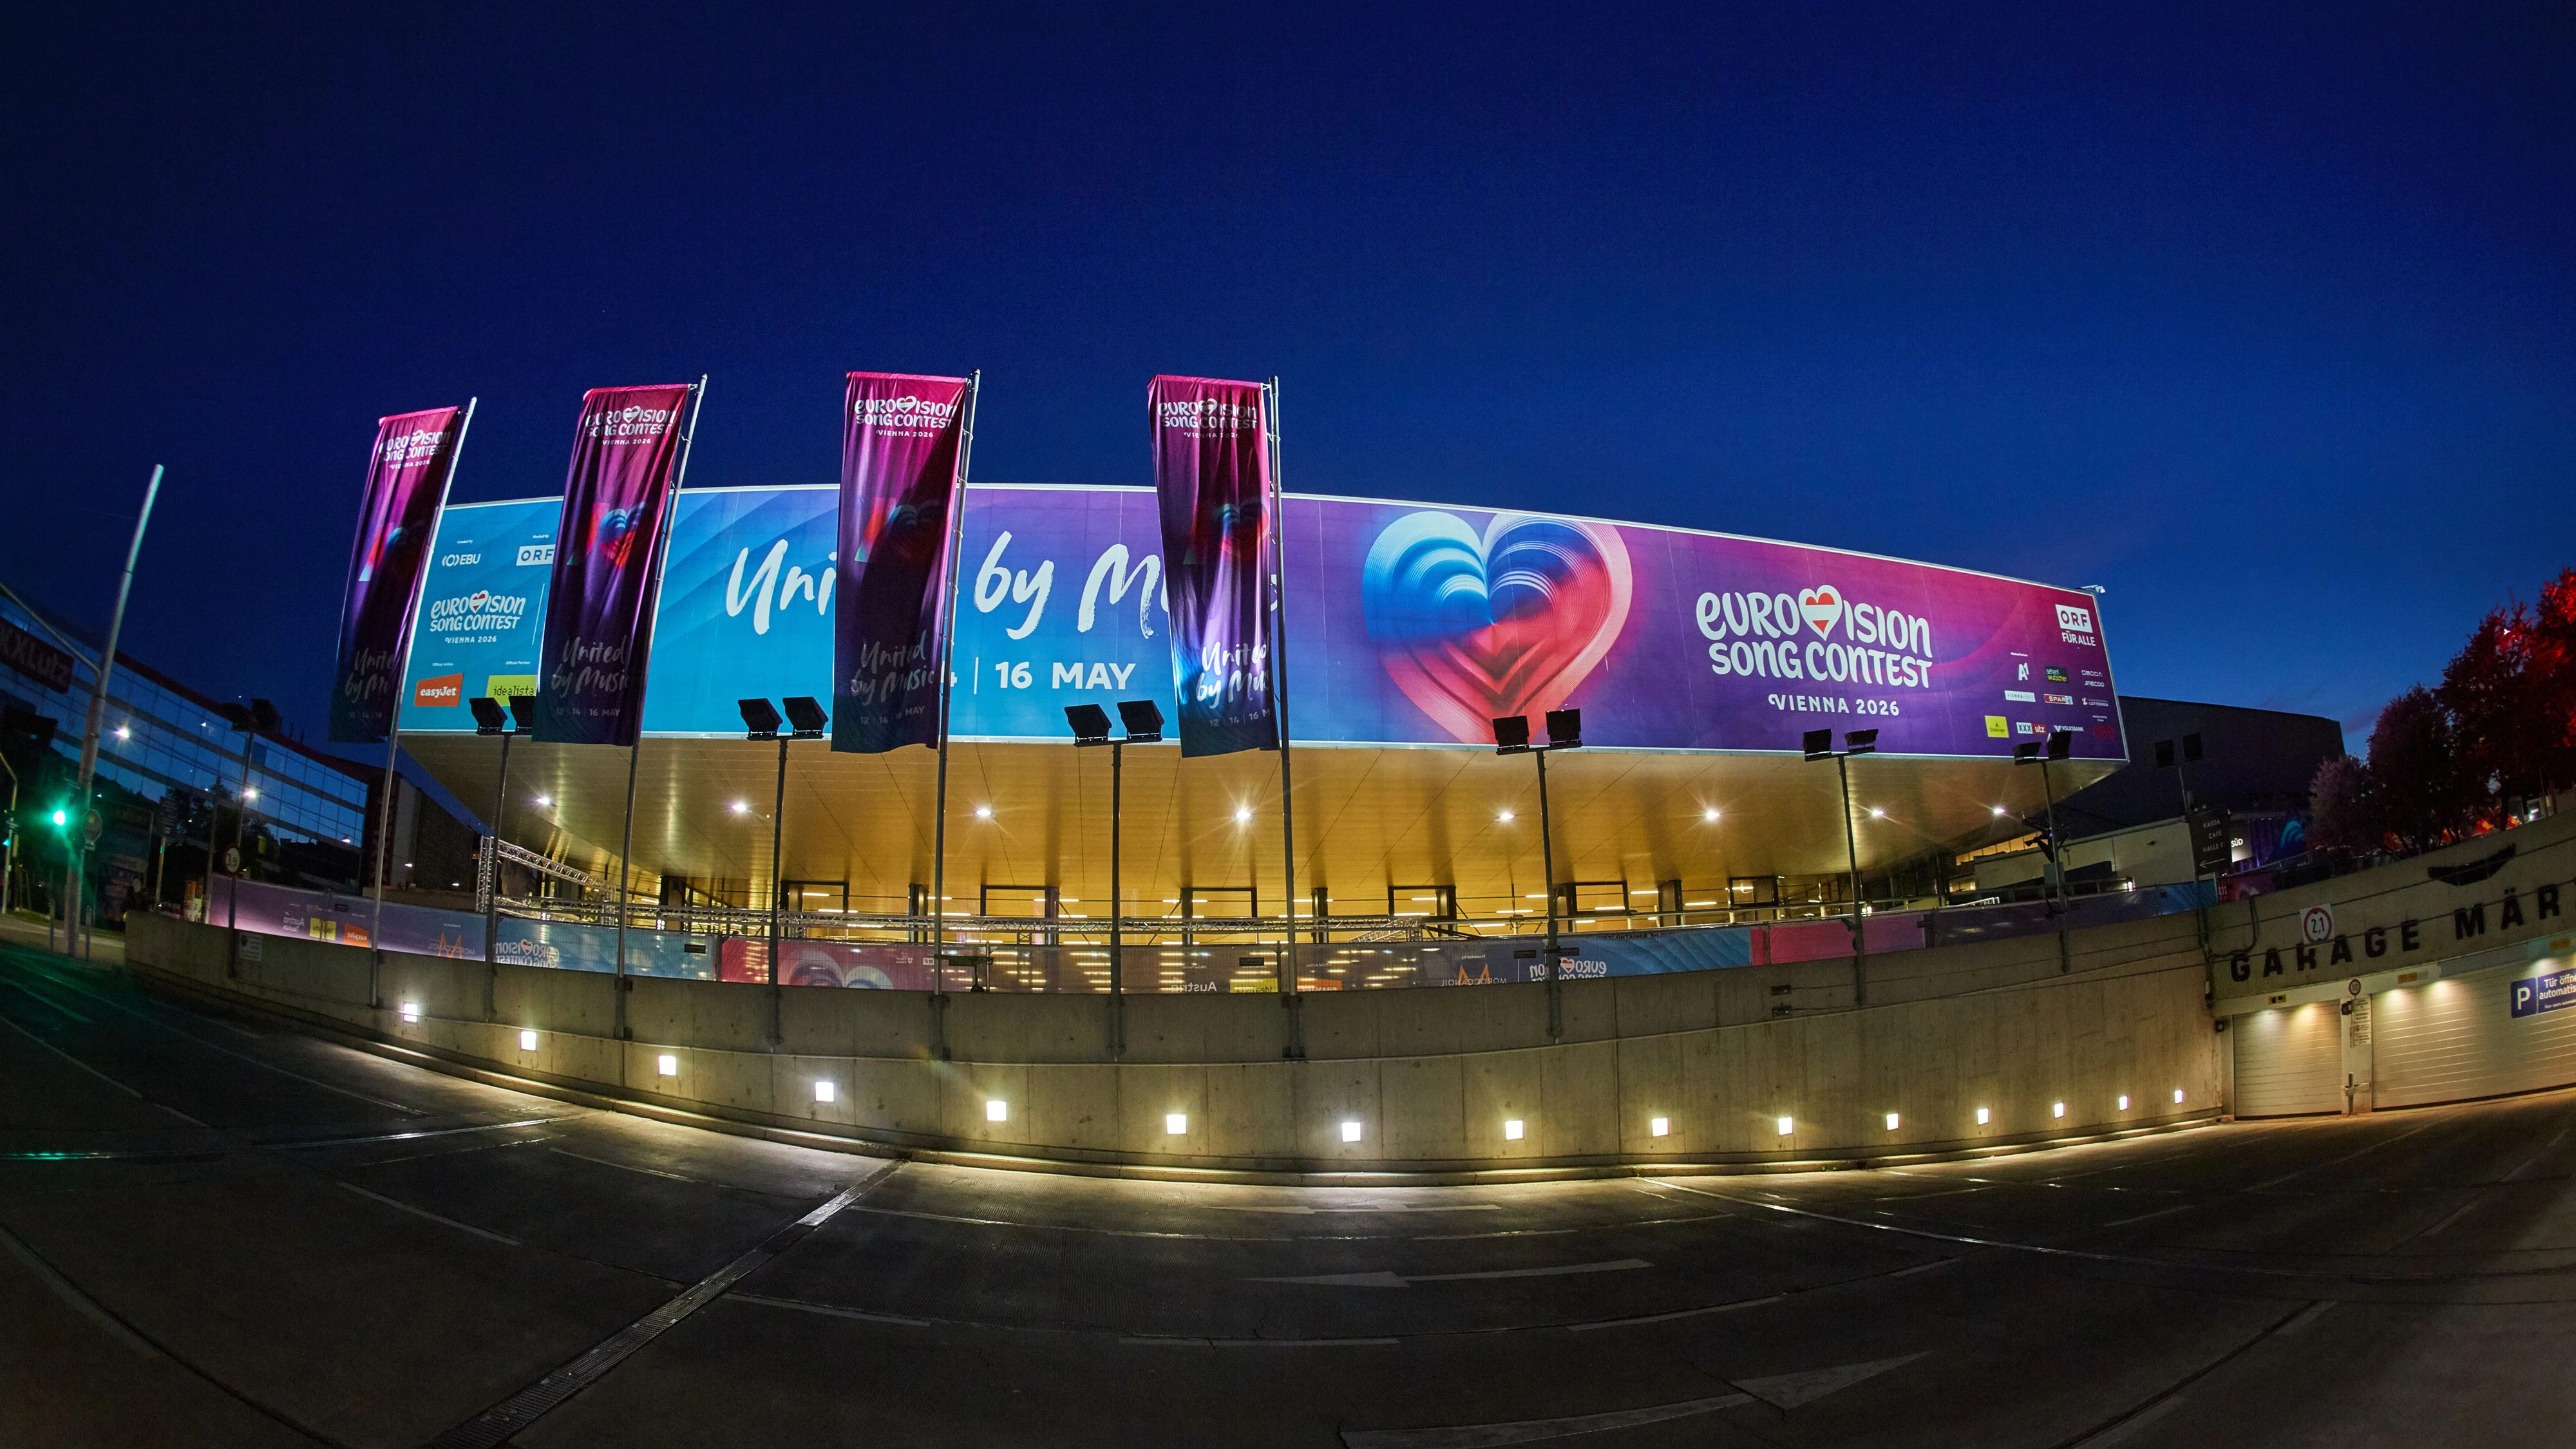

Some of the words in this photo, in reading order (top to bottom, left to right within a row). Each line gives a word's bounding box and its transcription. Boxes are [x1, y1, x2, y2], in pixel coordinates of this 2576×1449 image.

[855, 395, 958, 417] EUROVISION
[1158, 398, 1258, 419] EUROVISION
[618, 423, 672, 436] CONTEST
[857, 413, 893, 426] SONG
[895, 413, 952, 428] CONTEST
[1162, 416, 1198, 428] SONG
[1199, 416, 1258, 429] CONTEST
[380, 449, 405, 462] ONG
[521, 548, 554, 562] ORF
[726, 539, 837, 635] Uni
[974, 530, 1054, 639] by
[430, 590, 526, 619] EUROVISION
[430, 616, 462, 632] SONG
[464, 614, 520, 630] CONTEST
[1696, 585, 1933, 658] EUROVISION
[2060, 611, 2088, 627] ORF
[2061, 630, 2078, 644] FÜR
[2078, 635, 2096, 647] ALLE
[563, 634, 627, 667] United
[354, 647, 395, 676] Unite
[1709, 640, 1804, 679] SONG
[1805, 641, 1933, 688] CONTEST
[551, 663, 574, 699] by
[995, 661, 1033, 690] 16
[1052, 662, 1137, 690] MAY
[345, 672, 363, 703] by
[420, 686, 457, 698] easyJet
[493, 685, 535, 696] idealista
[851, 668, 876, 707] by
[880, 665, 935, 703] Music
[1196, 672, 1222, 709] by
[1227, 670, 1269, 703] Mus
[905, 706, 925, 714] MAY
[1768, 694, 1850, 714] VIENNA
[1856, 697, 1900, 716] 2026
[1209, 719, 1219, 727] 12
[1229, 716, 1240, 724] 14
[1249, 712, 1259, 721] 16
[2203, 819, 2221, 829] KASSA
[2202, 842, 2219, 853] HALLE
[2231, 837, 2244, 848] SÜD
[2454, 880, 2576, 940] MÄR
[2544, 978, 2558, 988] Tür
[2559, 973, 2576, 985] öffn
[2517, 987, 2530, 1010] P
[2539, 984, 2576, 999] automatis
